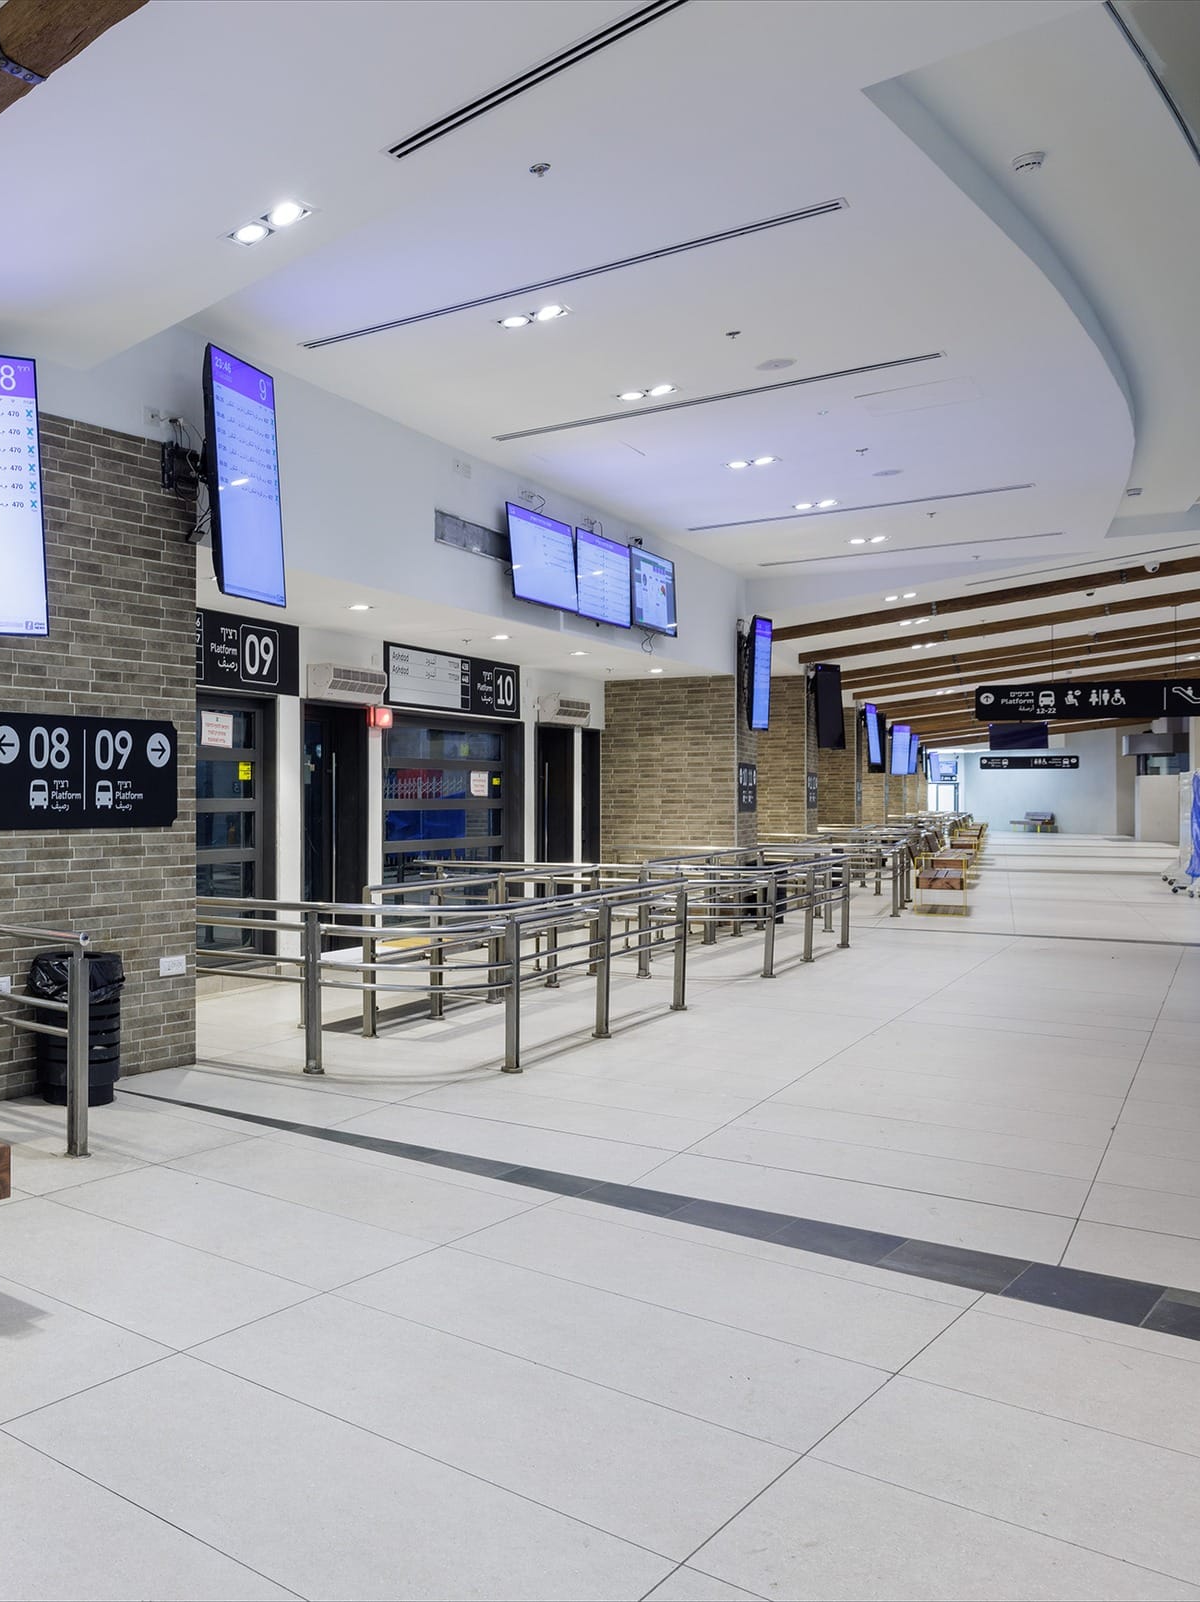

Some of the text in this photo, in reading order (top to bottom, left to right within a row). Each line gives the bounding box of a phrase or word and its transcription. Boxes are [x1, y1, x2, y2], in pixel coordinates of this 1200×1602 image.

[0, 364, 17, 391] 8
[258, 378, 267, 401] 9
[220, 626, 238, 642] רציף
[210, 642, 238, 656] Platform
[245, 633, 275, 676] 09
[217, 656, 238, 672] رصيف
[497, 674, 514, 706] 10
[1000, 697, 1034, 705] Platform
[29, 726, 71, 770] 08
[94, 729, 133, 770] 09
[53, 779, 69, 790] רציף
[117, 780, 132, 791] רציף
[51, 790, 82, 800] Platform
[115, 791, 144, 800] Platform
[51, 801, 70, 812] رصيف
[115, 801, 133, 811] رصيف
